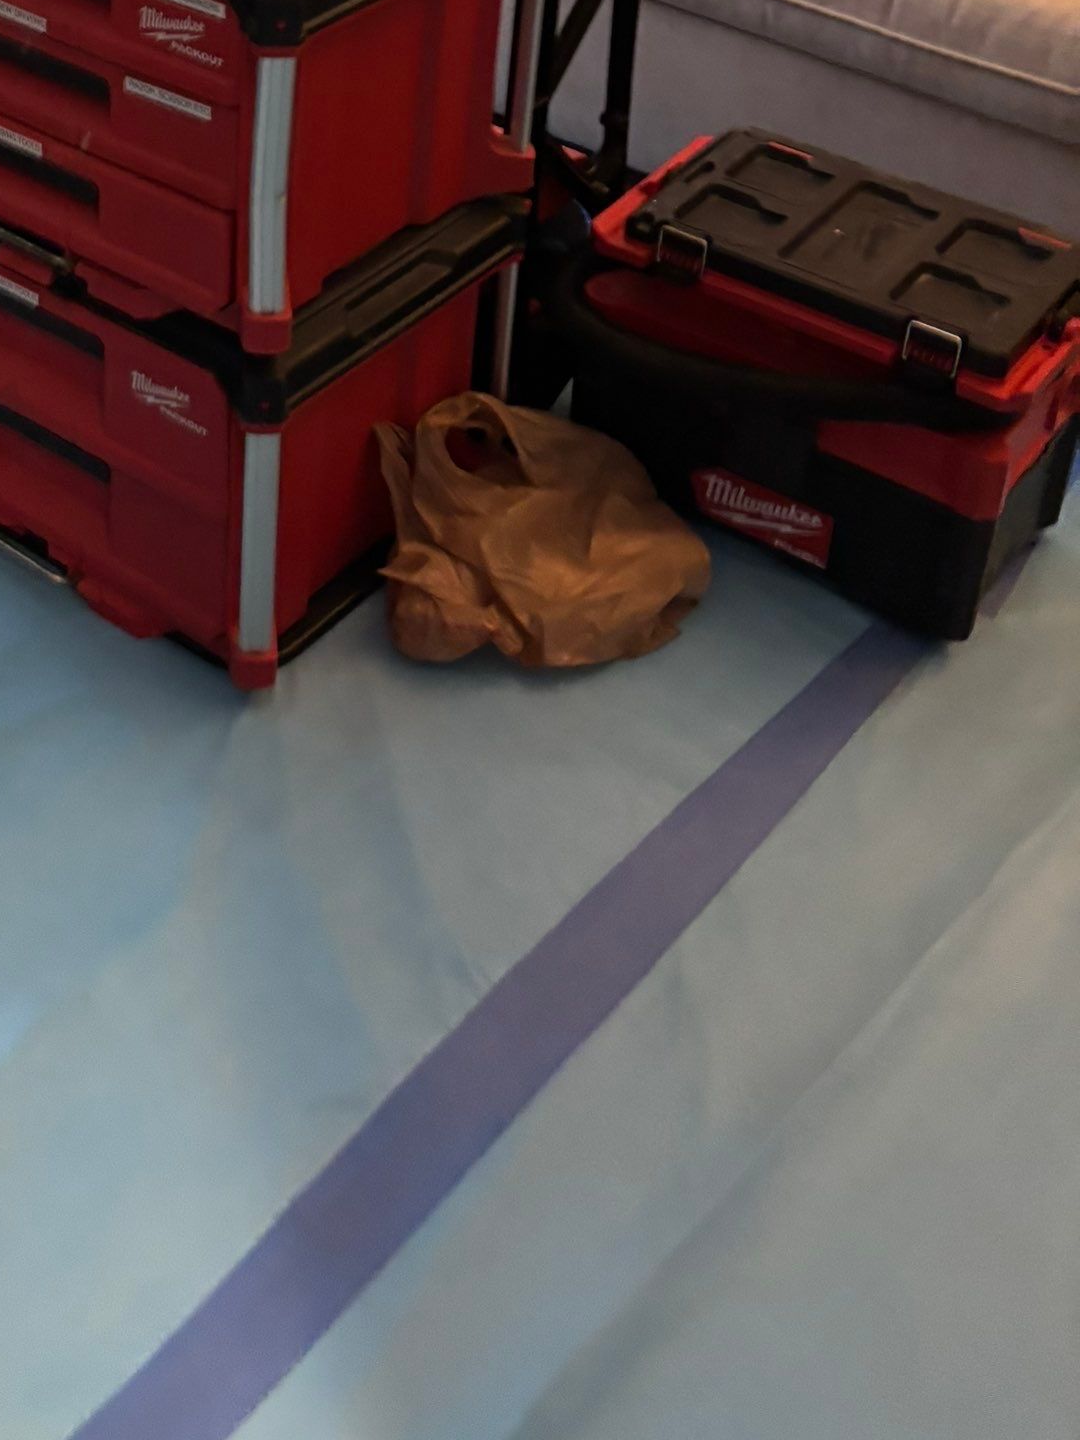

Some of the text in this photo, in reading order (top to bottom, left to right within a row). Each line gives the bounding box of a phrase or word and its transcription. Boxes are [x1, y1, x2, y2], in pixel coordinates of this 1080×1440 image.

[138, 5, 205, 32] Milwaukee
[171, 40, 223, 67] PACKOUT
[131, 369, 190, 402] Milwaukee
[702, 474, 823, 528] Milwaukee
